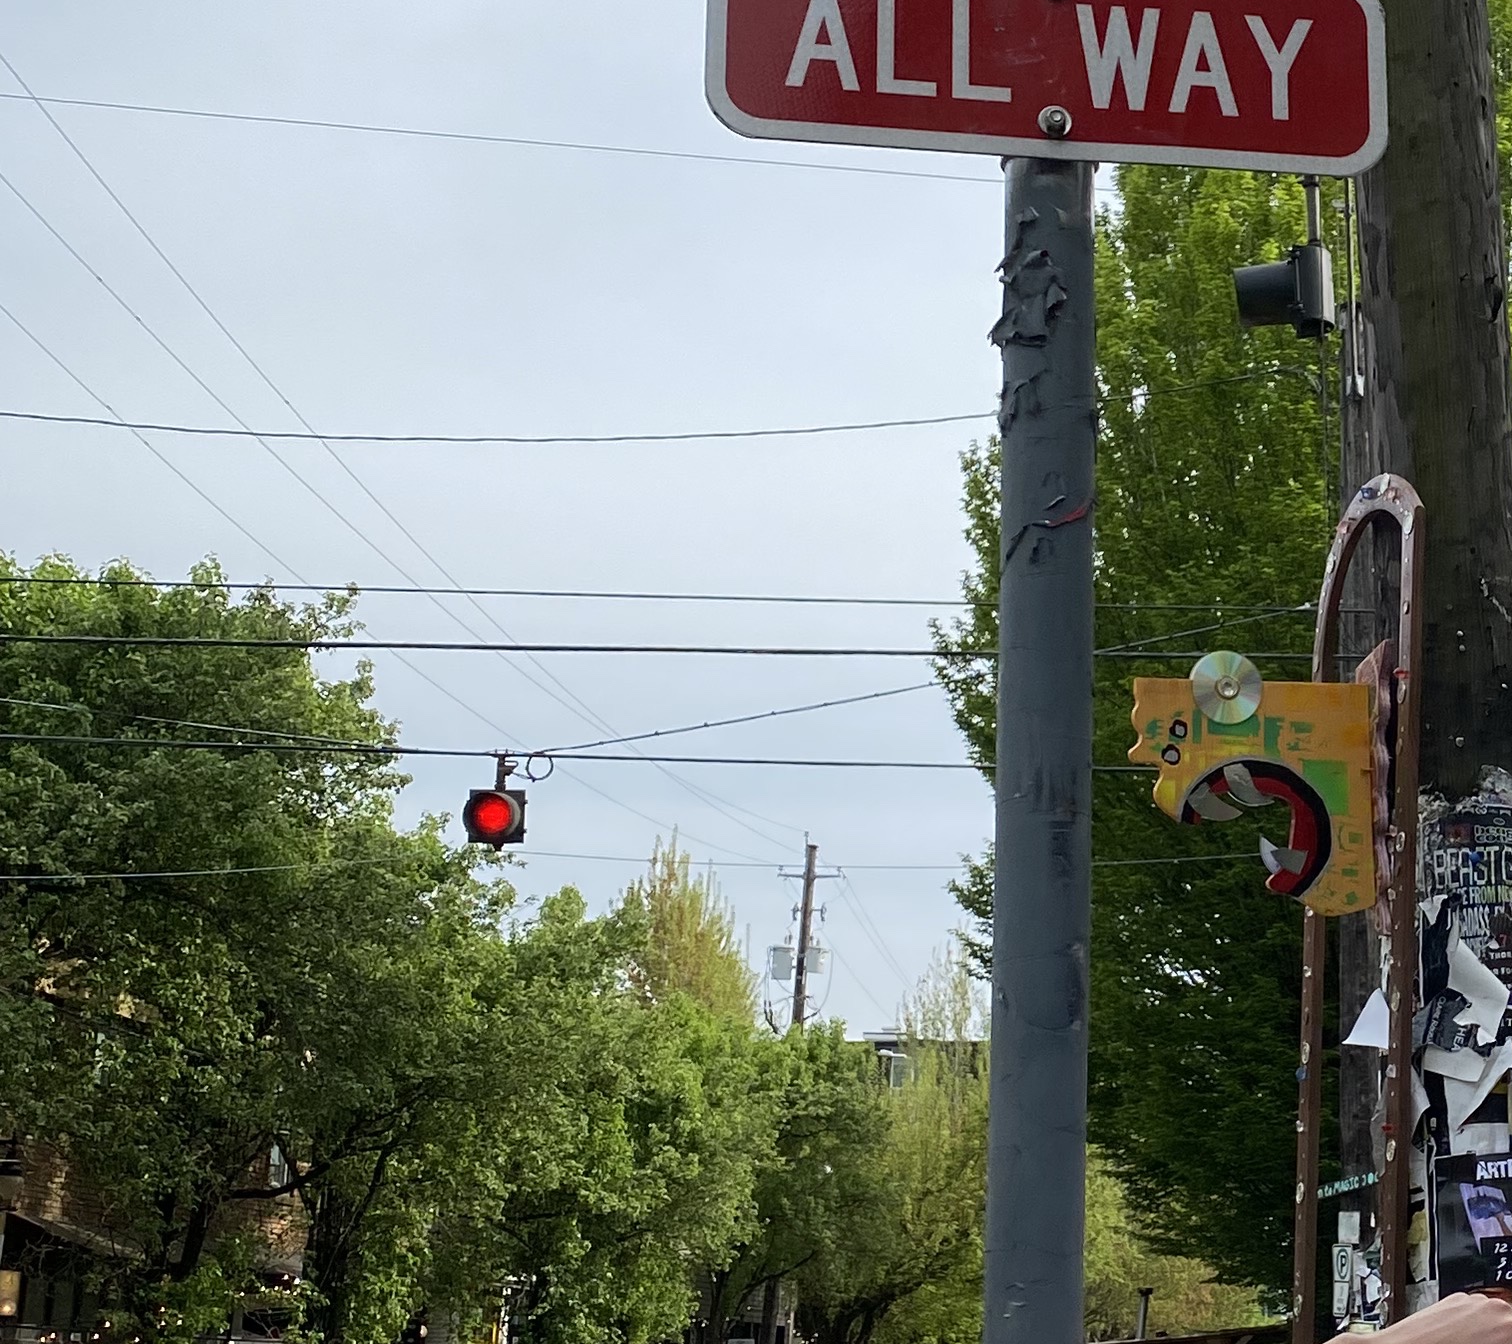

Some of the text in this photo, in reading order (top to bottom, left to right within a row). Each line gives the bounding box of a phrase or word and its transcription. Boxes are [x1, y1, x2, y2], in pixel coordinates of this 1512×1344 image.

[1076, 3, 1315, 122] WAY
[1433, 845, 1499, 889] BEAST
[1494, 1242, 1508, 1254] 12
